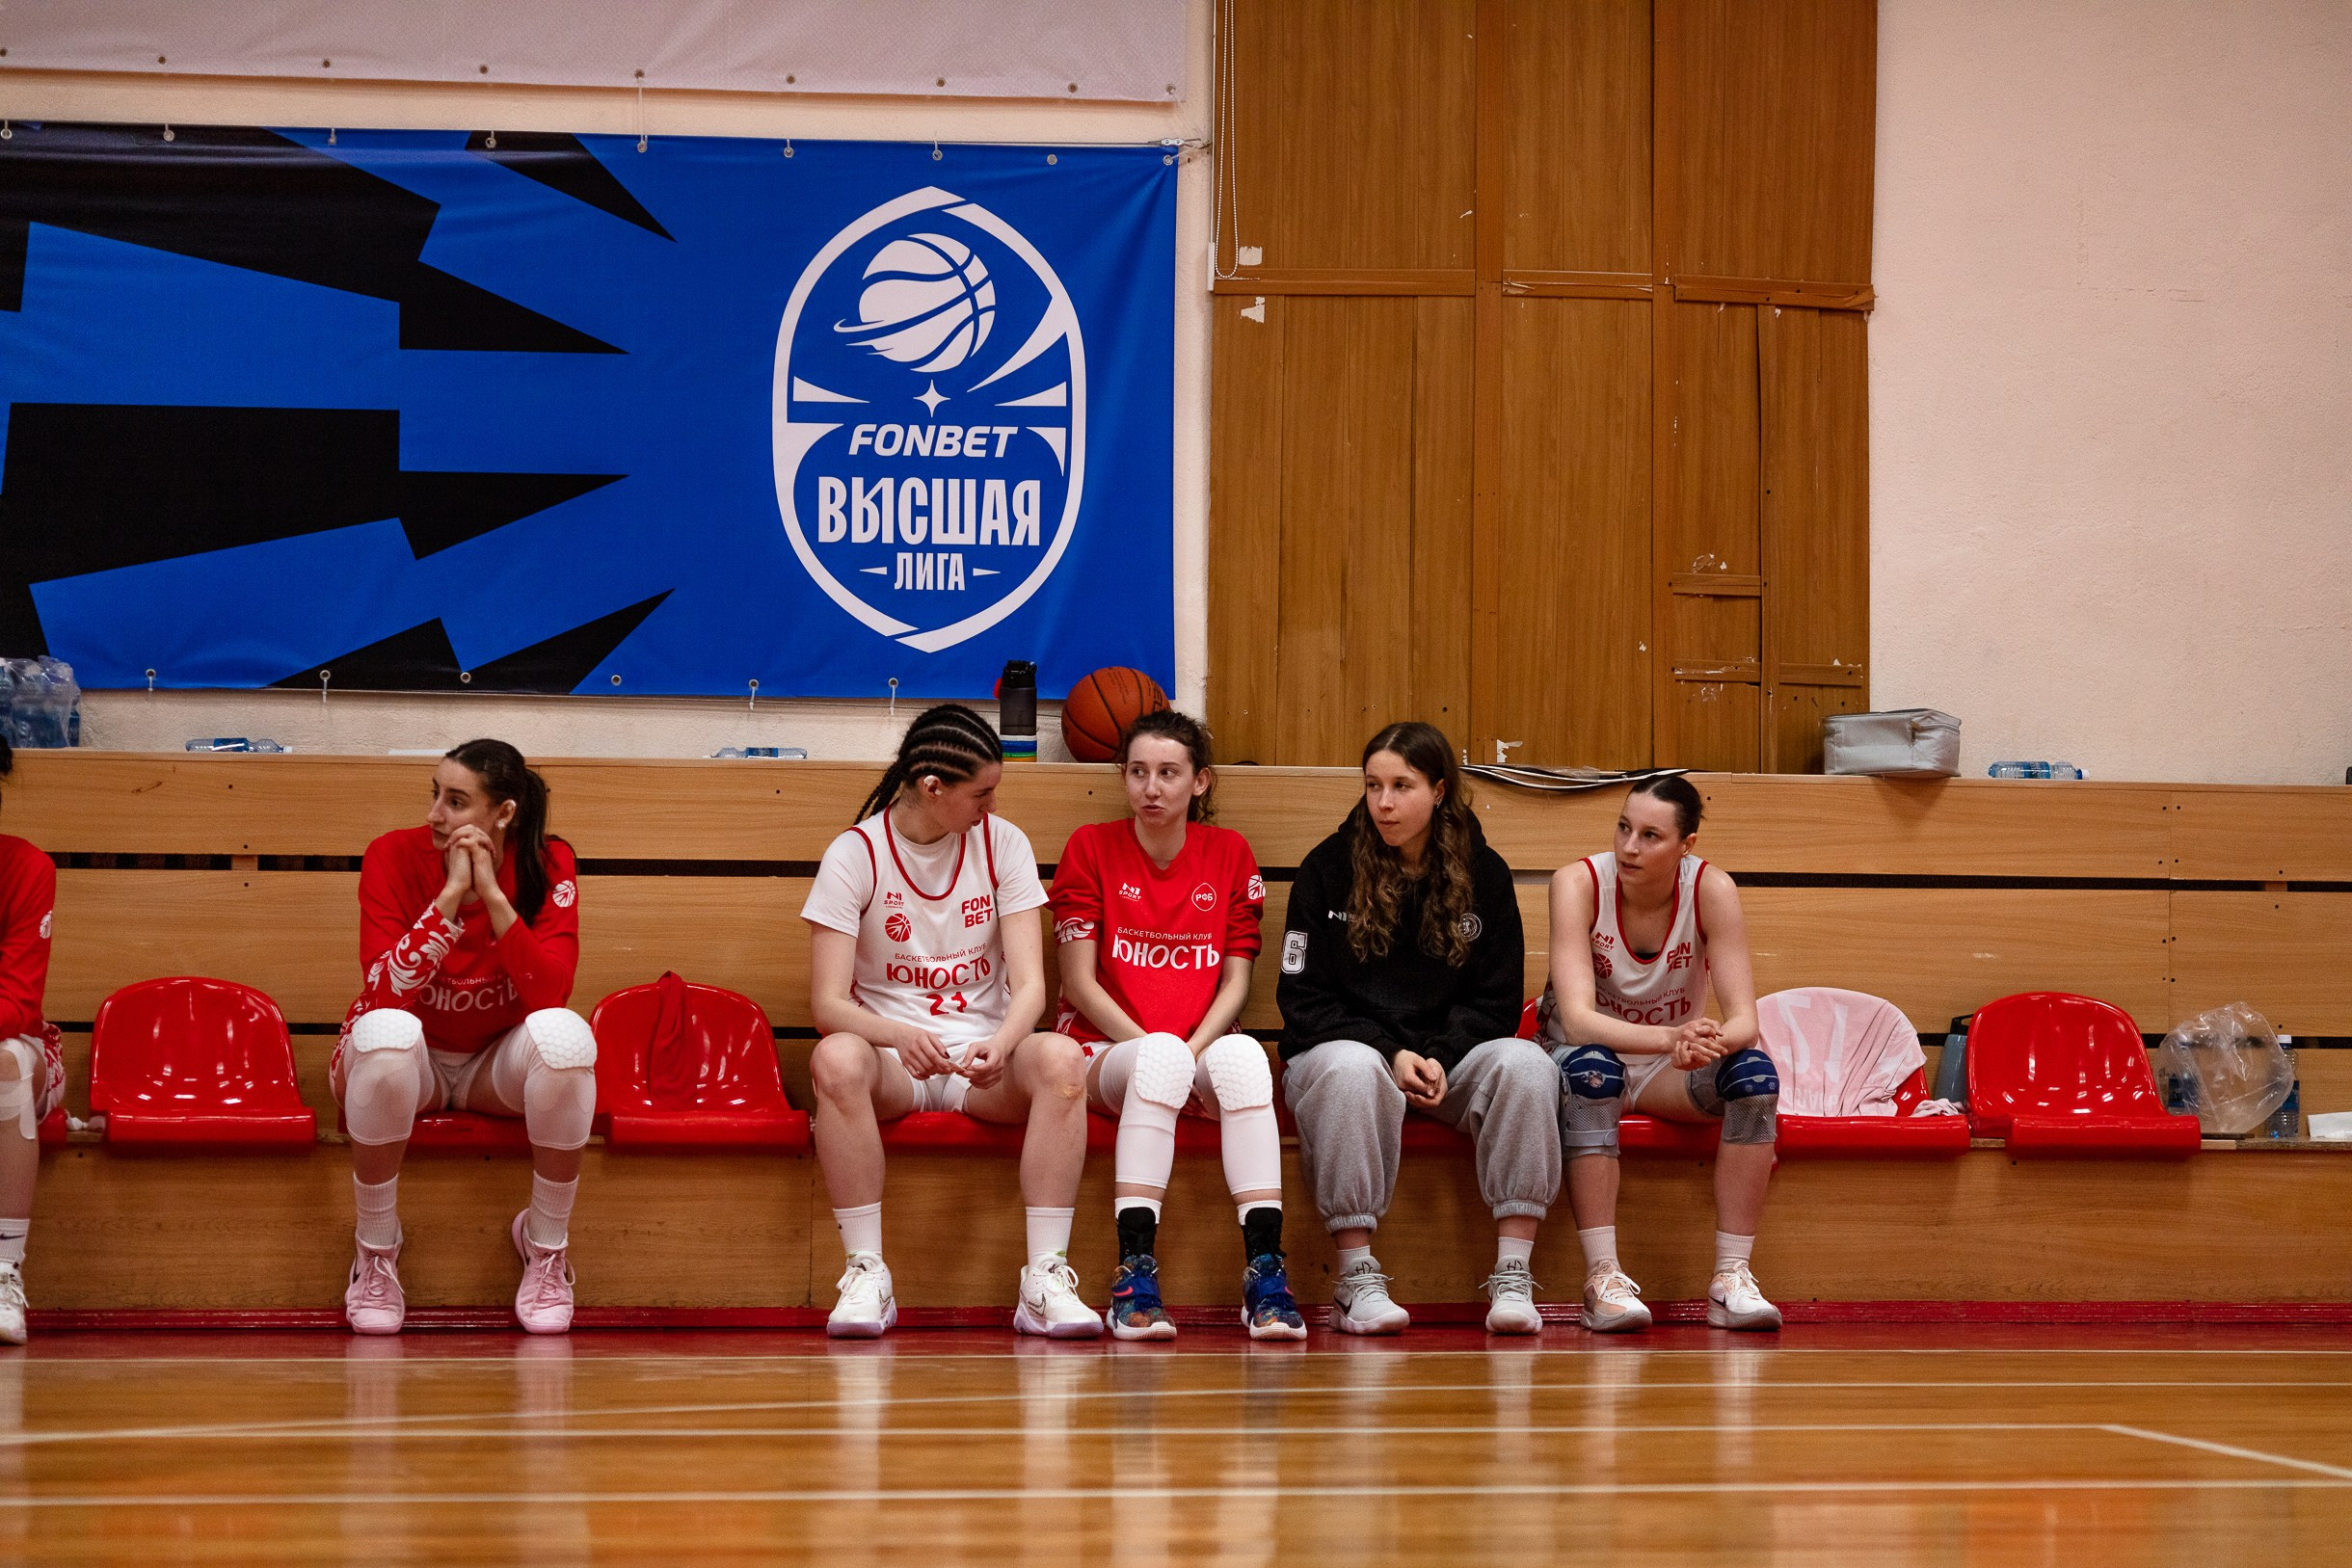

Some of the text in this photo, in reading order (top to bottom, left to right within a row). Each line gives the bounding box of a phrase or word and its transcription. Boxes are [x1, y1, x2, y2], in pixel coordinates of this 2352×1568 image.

[848, 423, 1018, 458] FONBET
[817, 476, 1040, 545] ВЫСШАЯ
[895, 552, 965, 590] ЛИГА
[961, 894, 991, 915] FON
[964, 907, 994, 928] BET
[1117, 926, 1213, 942] БАСКЕТБОЛЬНЫЙ КЛУБ
[895, 943, 987, 964] БАСКЕТБОЛЬНЫЙ КЛУБ
[1111, 933, 1221, 971] ЮНОСТЬ
[1280, 930, 1308, 974] 6
[886, 952, 992, 991] ЮНОСТЬ
[1663, 987, 1686, 999] КЛУБ
